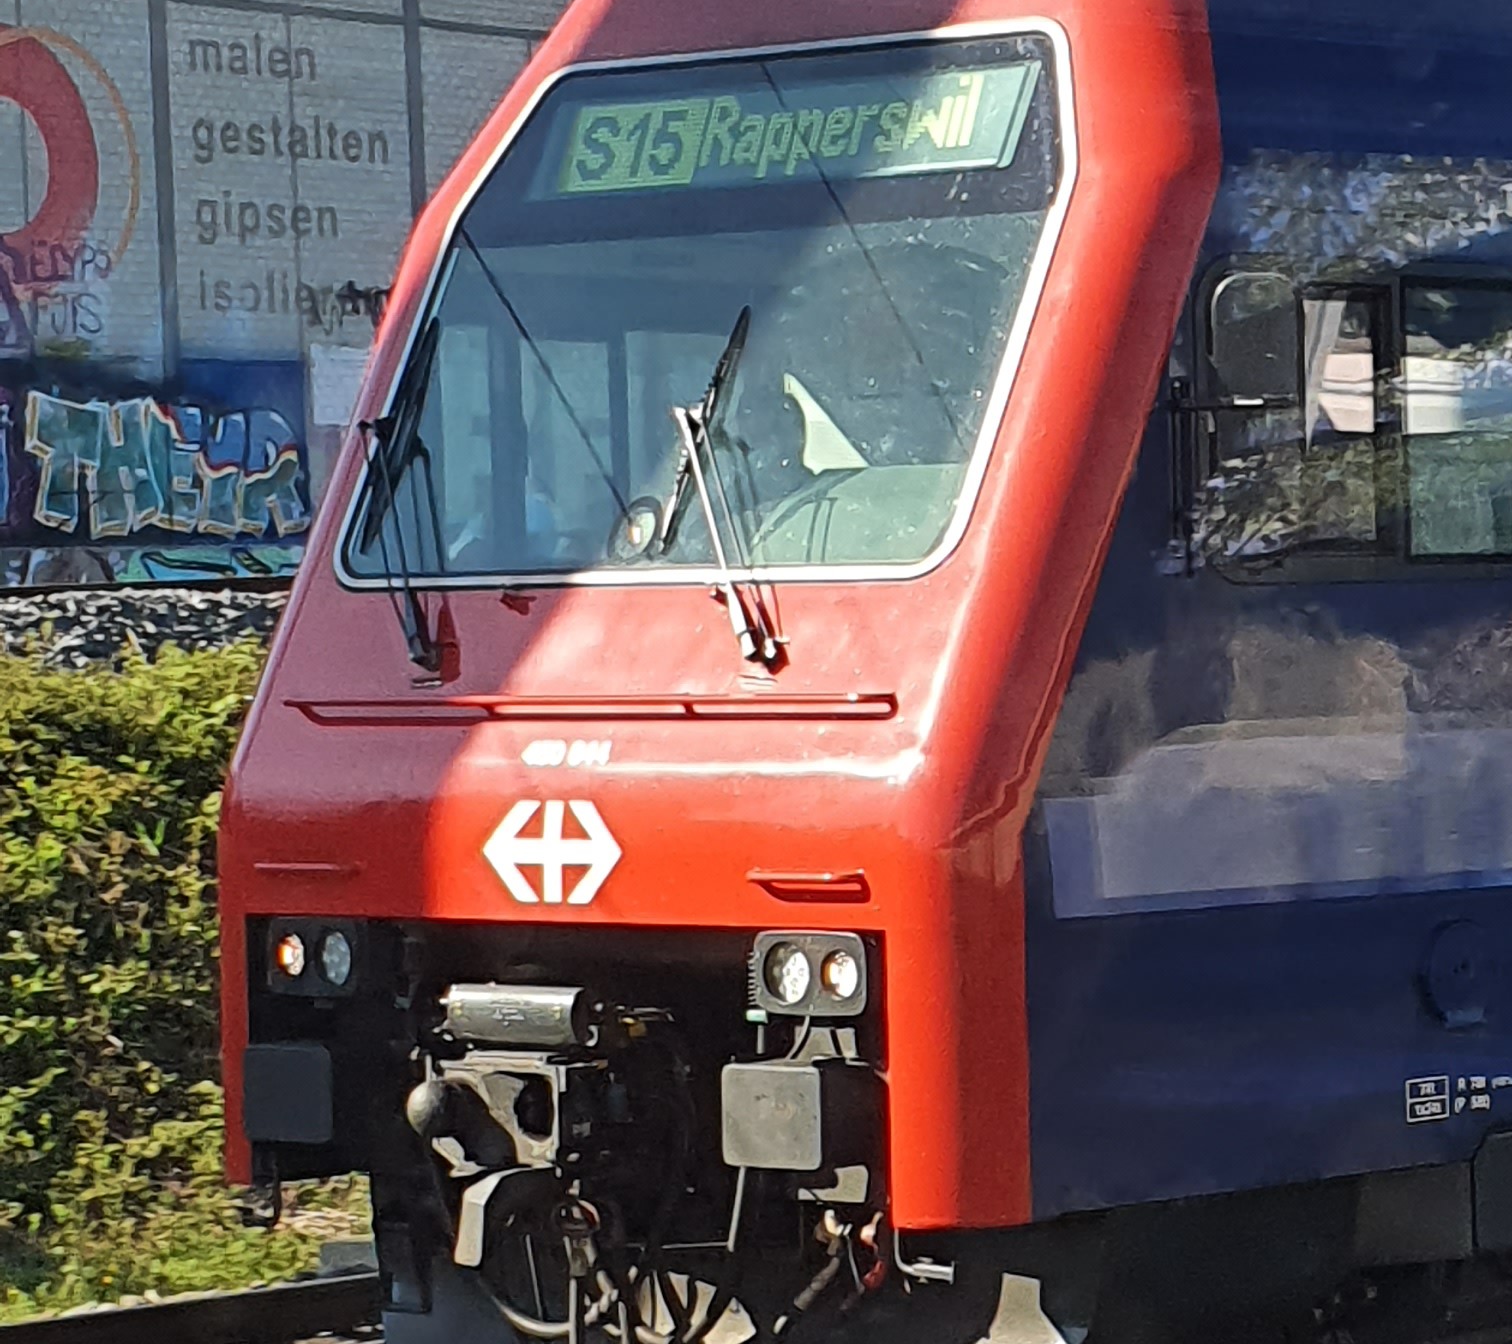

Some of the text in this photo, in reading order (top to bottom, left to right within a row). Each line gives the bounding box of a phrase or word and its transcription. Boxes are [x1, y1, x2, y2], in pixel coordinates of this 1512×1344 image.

[187, 32, 317, 81] malen
[191, 114, 389, 165] gestalten
[574, 74, 984, 182] S15 Rapperswil
[195, 190, 339, 244] gipsen
